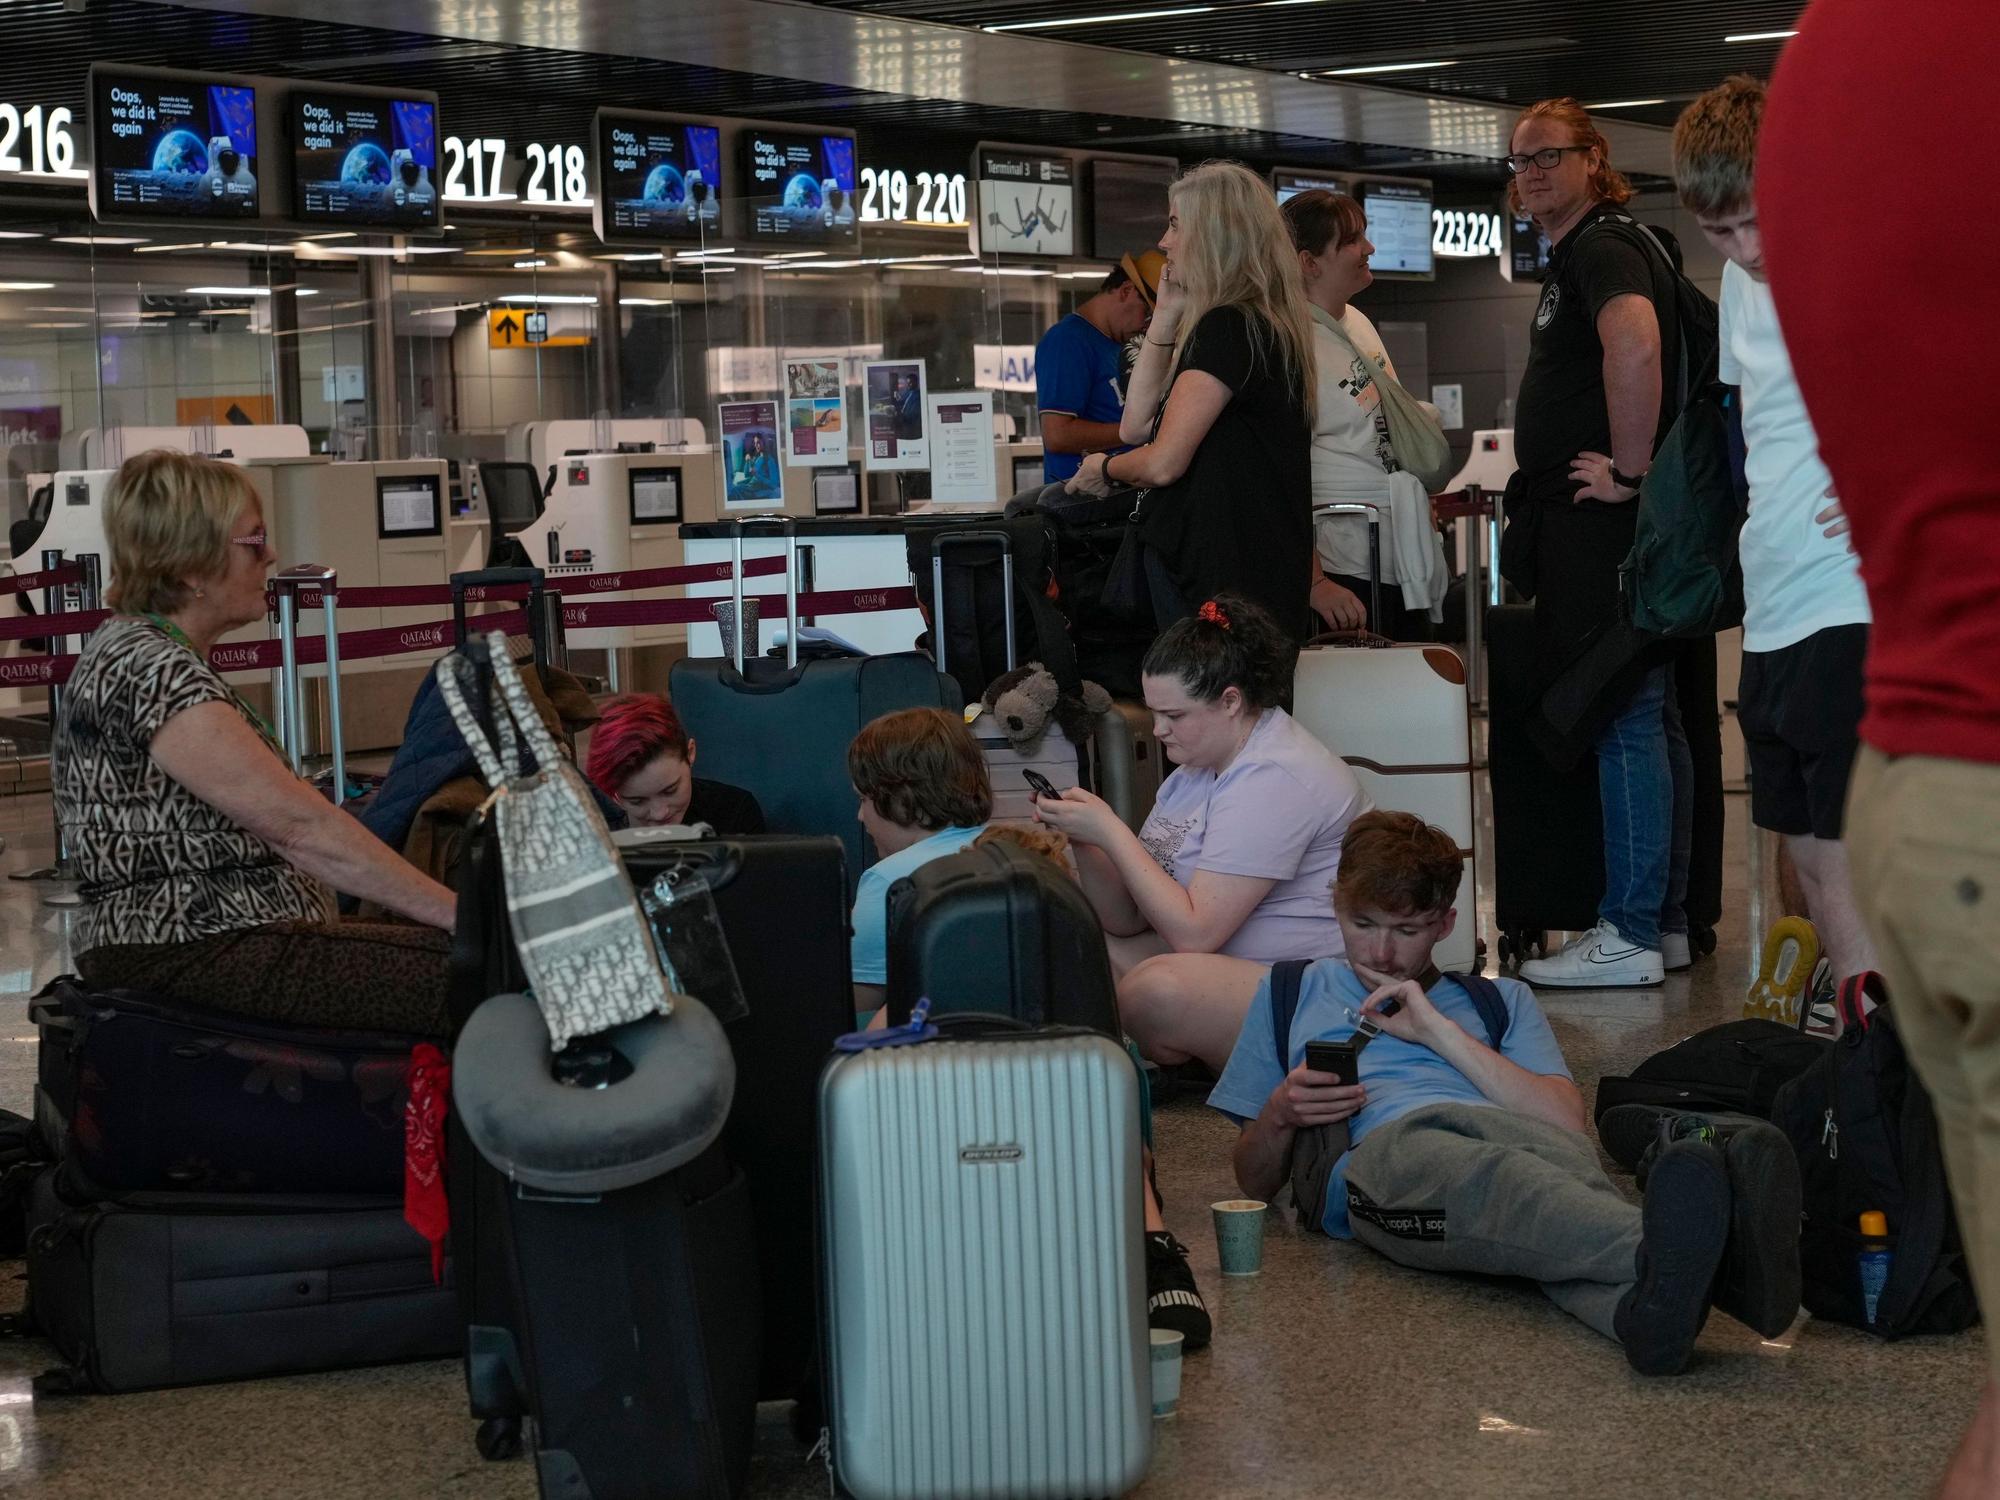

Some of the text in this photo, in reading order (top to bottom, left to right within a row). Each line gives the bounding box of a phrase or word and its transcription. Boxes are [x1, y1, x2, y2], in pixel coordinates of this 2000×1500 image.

[111, 88, 141, 106] Oops,
[111, 105, 156, 120] we did it
[303, 103, 331, 120] Oops,
[112, 120, 142, 137] again
[304, 122, 317, 132] we
[319, 120, 334, 133] did
[336, 121, 344, 134] it
[0, 103, 74, 173] 216
[303, 135, 332, 150] again
[613, 146, 625, 155] we
[625, 144, 638, 156] did
[443, 136, 506, 198] 217
[613, 157, 637, 172] again
[754, 157, 766, 165] we
[766, 154, 778, 167] did
[986, 160, 1031, 176] Terminal 3
[526, 143, 587, 201] 218
[860, 167, 907, 221] 219
[916, 172, 965, 224] 220
[1432, 209, 1466, 253] 223
[1467, 212, 1502, 256] 224
[589, 576, 612, 589] QATAR
[302, 593, 325, 606] QATA
[853, 594, 877, 607] QATAR
[401, 629, 431, 646] QATAR
[212, 649, 246, 666] QATAR
[0, 663, 39, 680] QATAR
